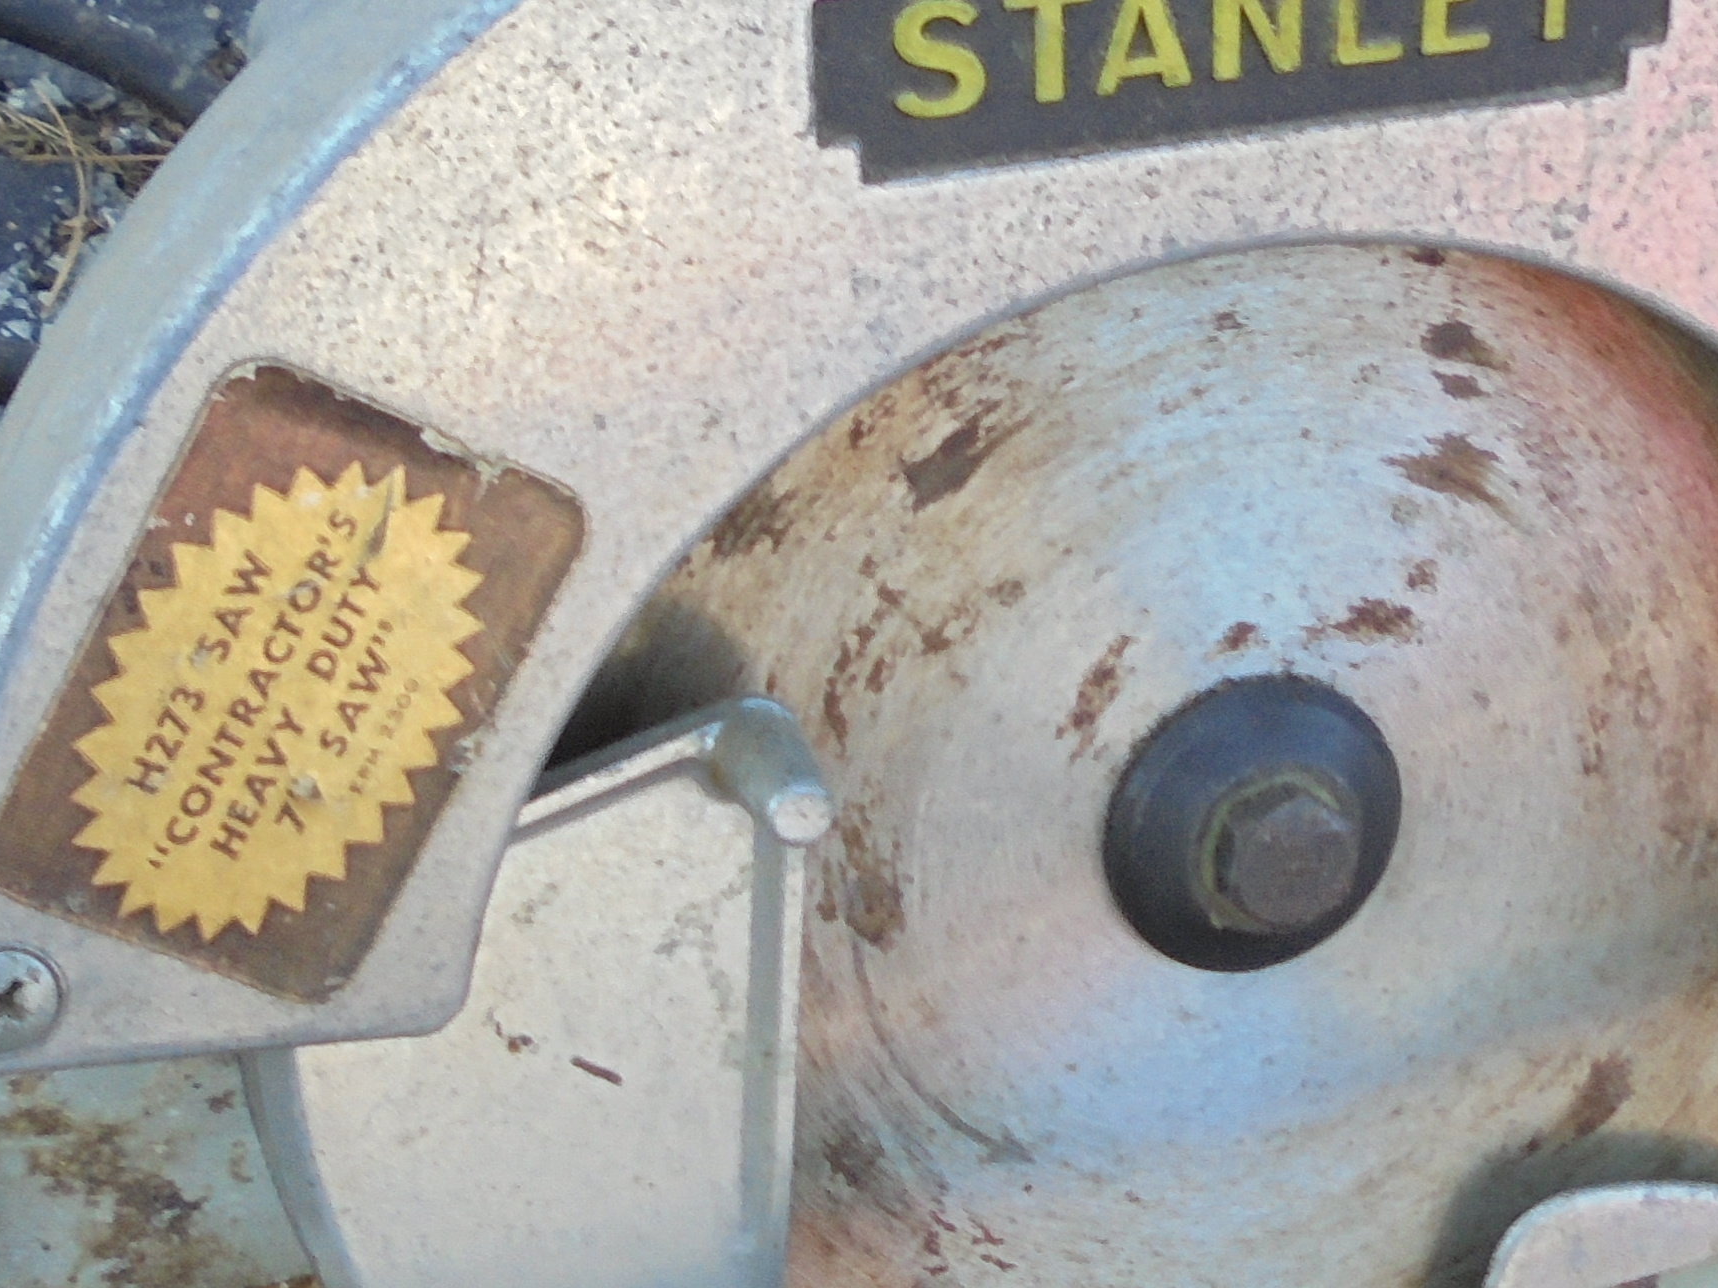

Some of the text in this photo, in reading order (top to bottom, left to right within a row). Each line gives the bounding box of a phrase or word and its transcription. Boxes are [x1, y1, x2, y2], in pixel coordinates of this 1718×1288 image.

[124, 549, 272, 794] H273 SAW
[210, 566, 380, 860] HEAVY DUTY
